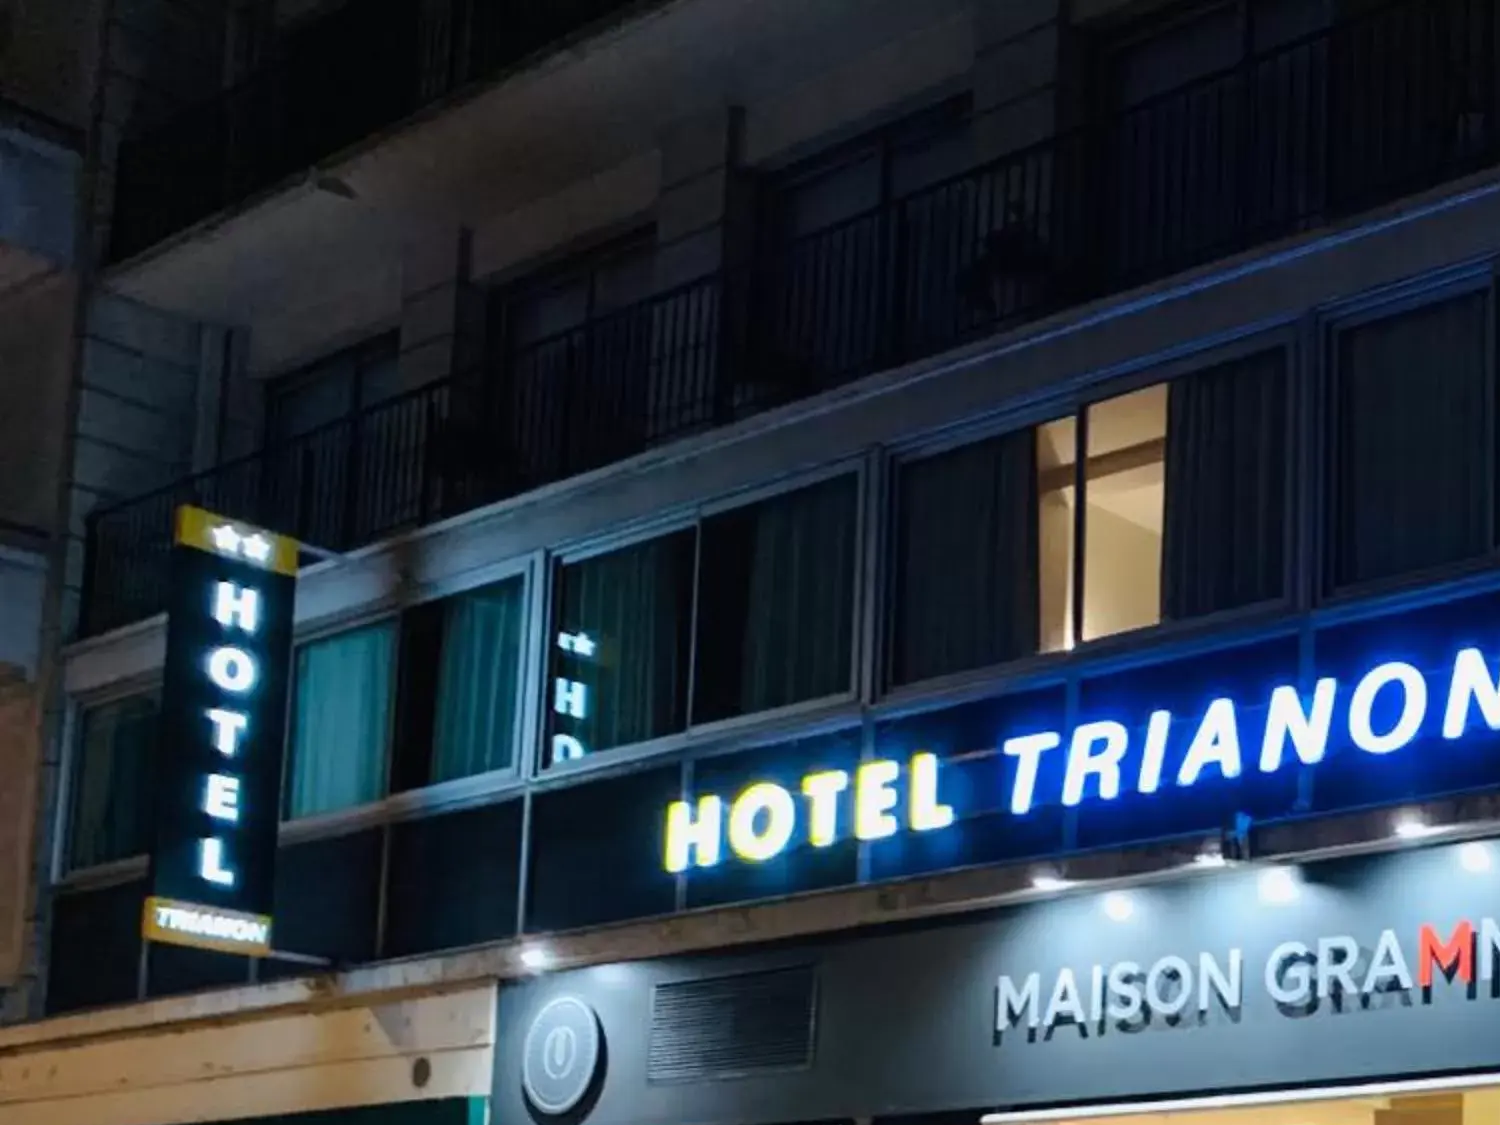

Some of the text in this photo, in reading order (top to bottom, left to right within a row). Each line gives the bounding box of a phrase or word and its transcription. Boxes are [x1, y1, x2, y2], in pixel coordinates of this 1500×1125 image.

[199, 579, 259, 886] HOTEL
[664, 752, 954, 873] HOTEL
[997, 947, 1242, 1032] MAISON
